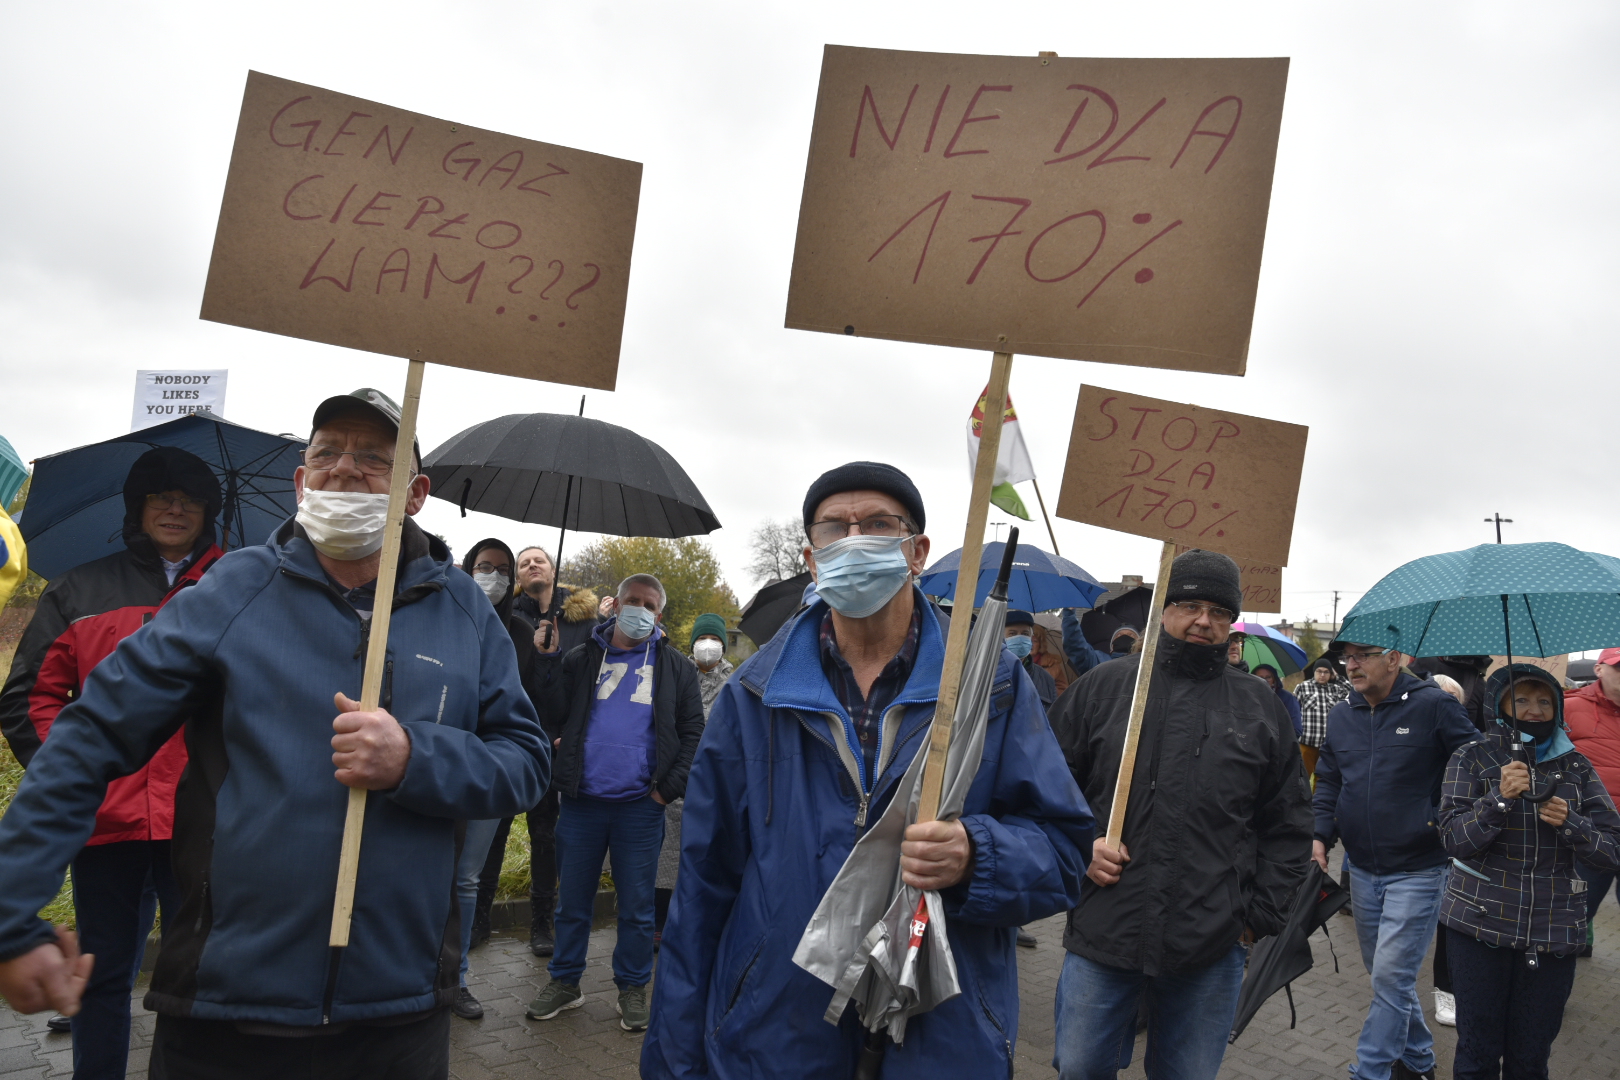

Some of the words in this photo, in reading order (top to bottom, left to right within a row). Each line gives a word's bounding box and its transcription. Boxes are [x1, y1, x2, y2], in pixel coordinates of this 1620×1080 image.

[850, 83, 1012, 158] NIE
[1044, 84, 1242, 174] DLA
[442, 142, 569, 197] GAZ
[283, 174, 522, 249] CIEPŁO
[868, 190, 1182, 308] 170%
[154, 375, 211, 385] NOBODY
[162, 390, 199, 400] LIKES
[146, 405, 174, 415] YOU
[1088, 397, 1240, 453] STOP
[1123, 449, 1215, 490] DLA
[1096, 484, 1239, 537] 170%
[1241, 585, 1280, 604] 170%
[597, 662, 654, 705] 71
